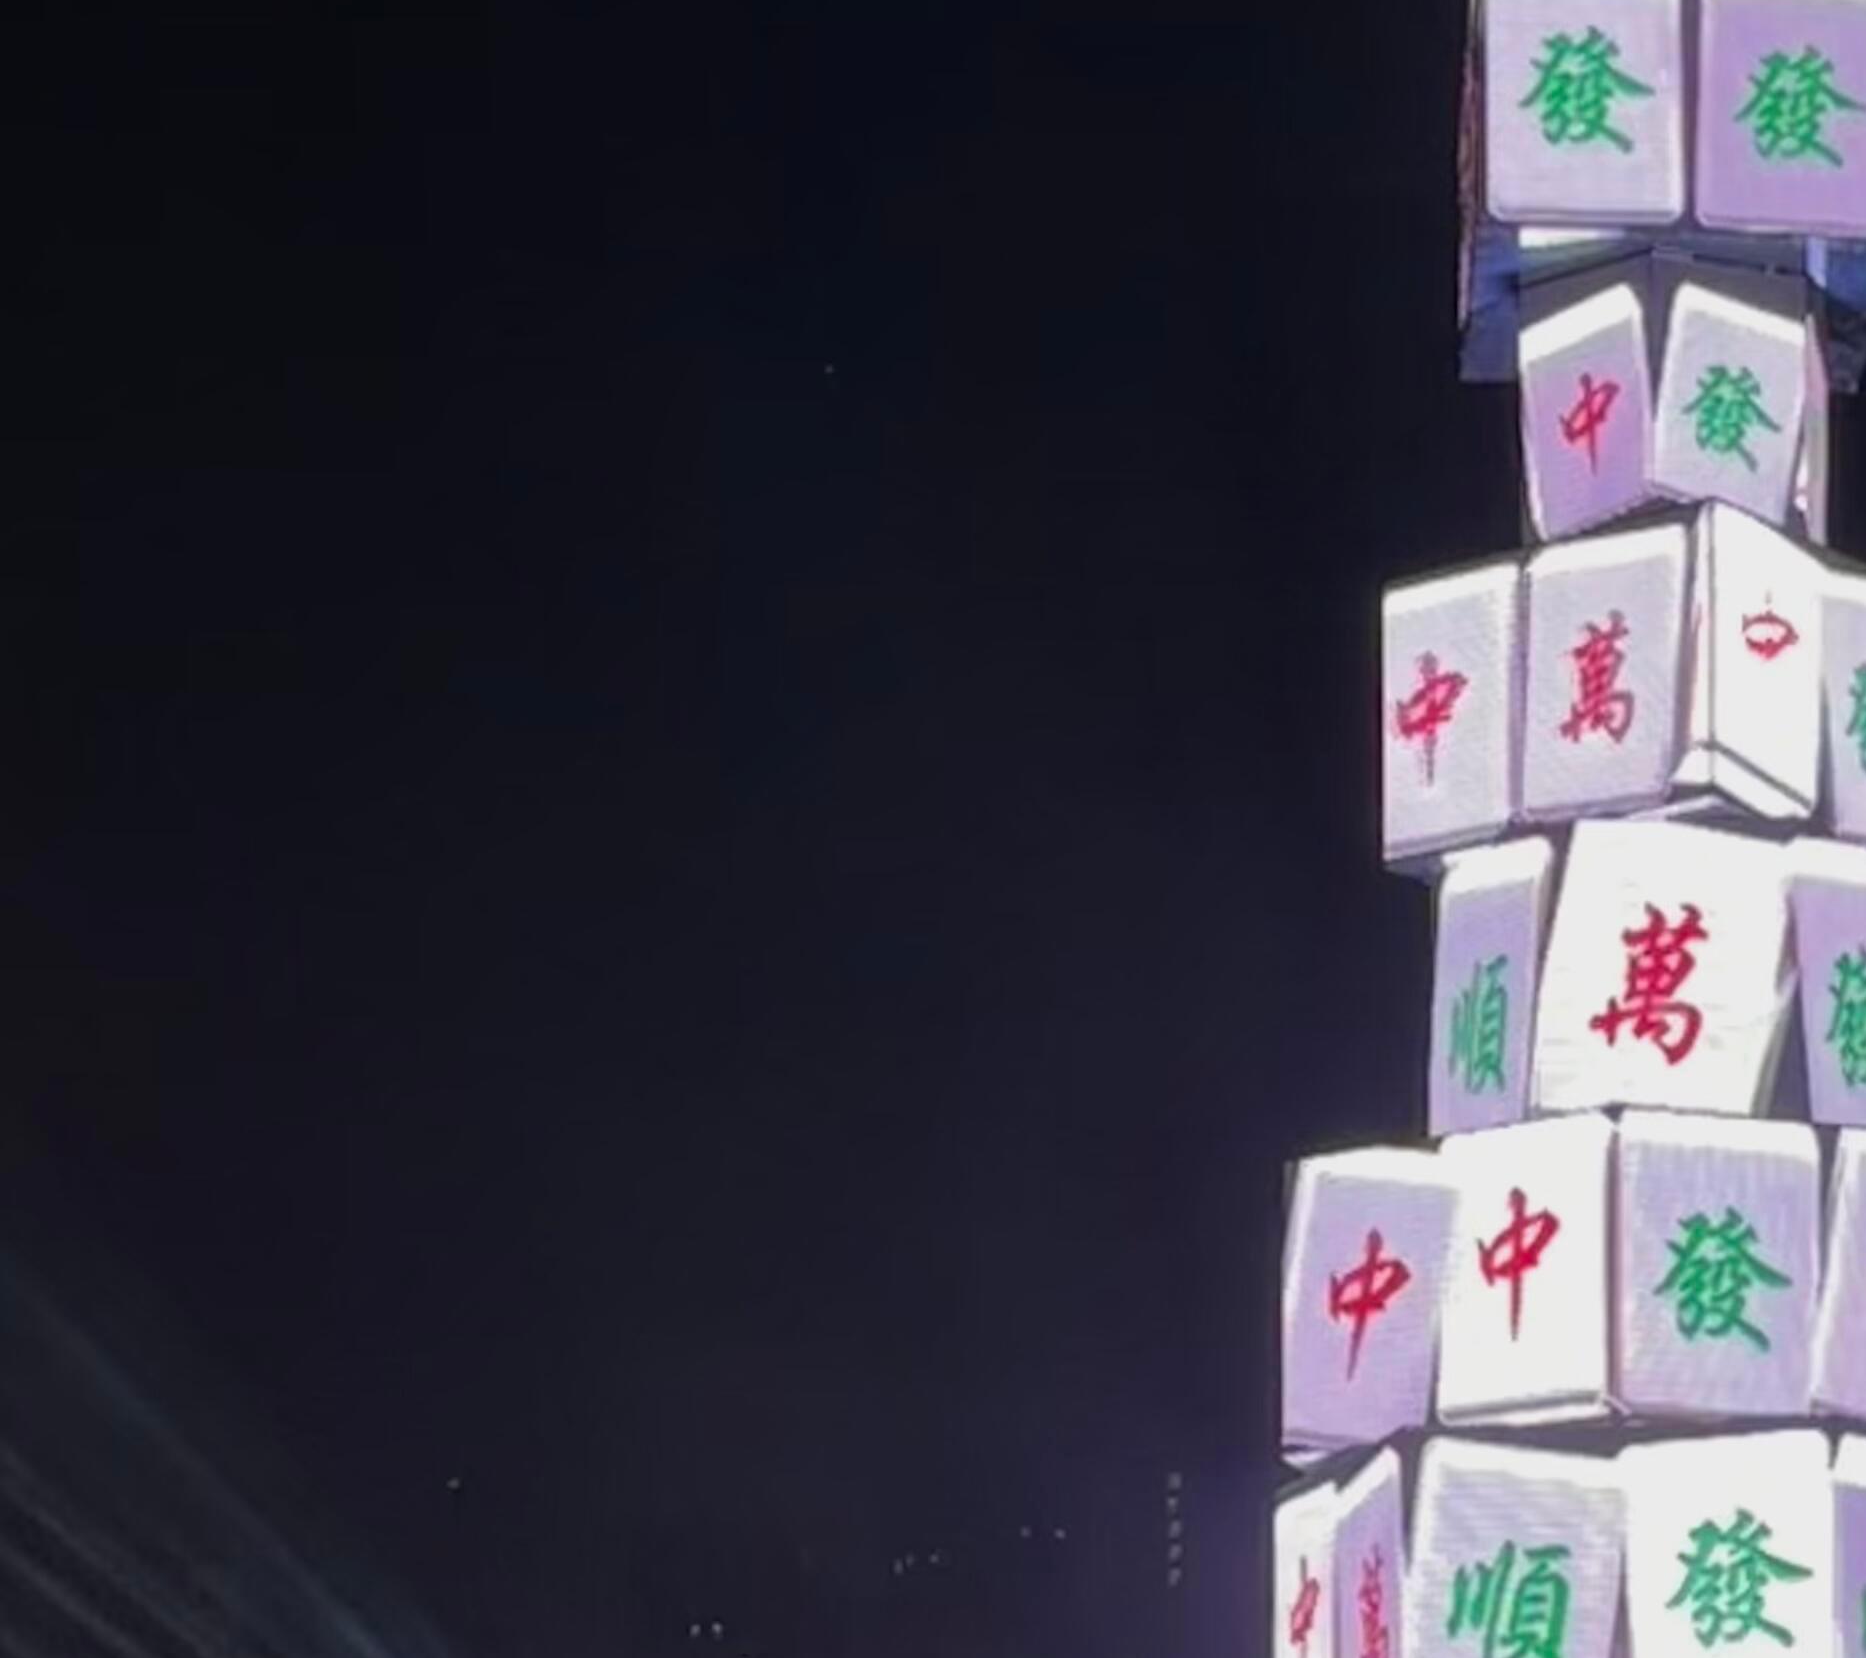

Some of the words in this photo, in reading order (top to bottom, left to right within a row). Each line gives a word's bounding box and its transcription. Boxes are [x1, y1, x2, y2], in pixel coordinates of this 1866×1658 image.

[1519, 26, 1657, 156] 發
[1558, 374, 1621, 476] 中
[1682, 365, 1783, 471] 發
[1393, 651, 1469, 788] 中
[1561, 608, 1635, 744] 萬
[1449, 953, 1510, 1094] 順
[1589, 901, 1710, 1066] 萬
[1328, 1228, 1412, 1382] 中
[1477, 1187, 1562, 1341] 中
[1653, 1206, 1793, 1353] 發
[1664, 1507, 1815, 1651] 發
